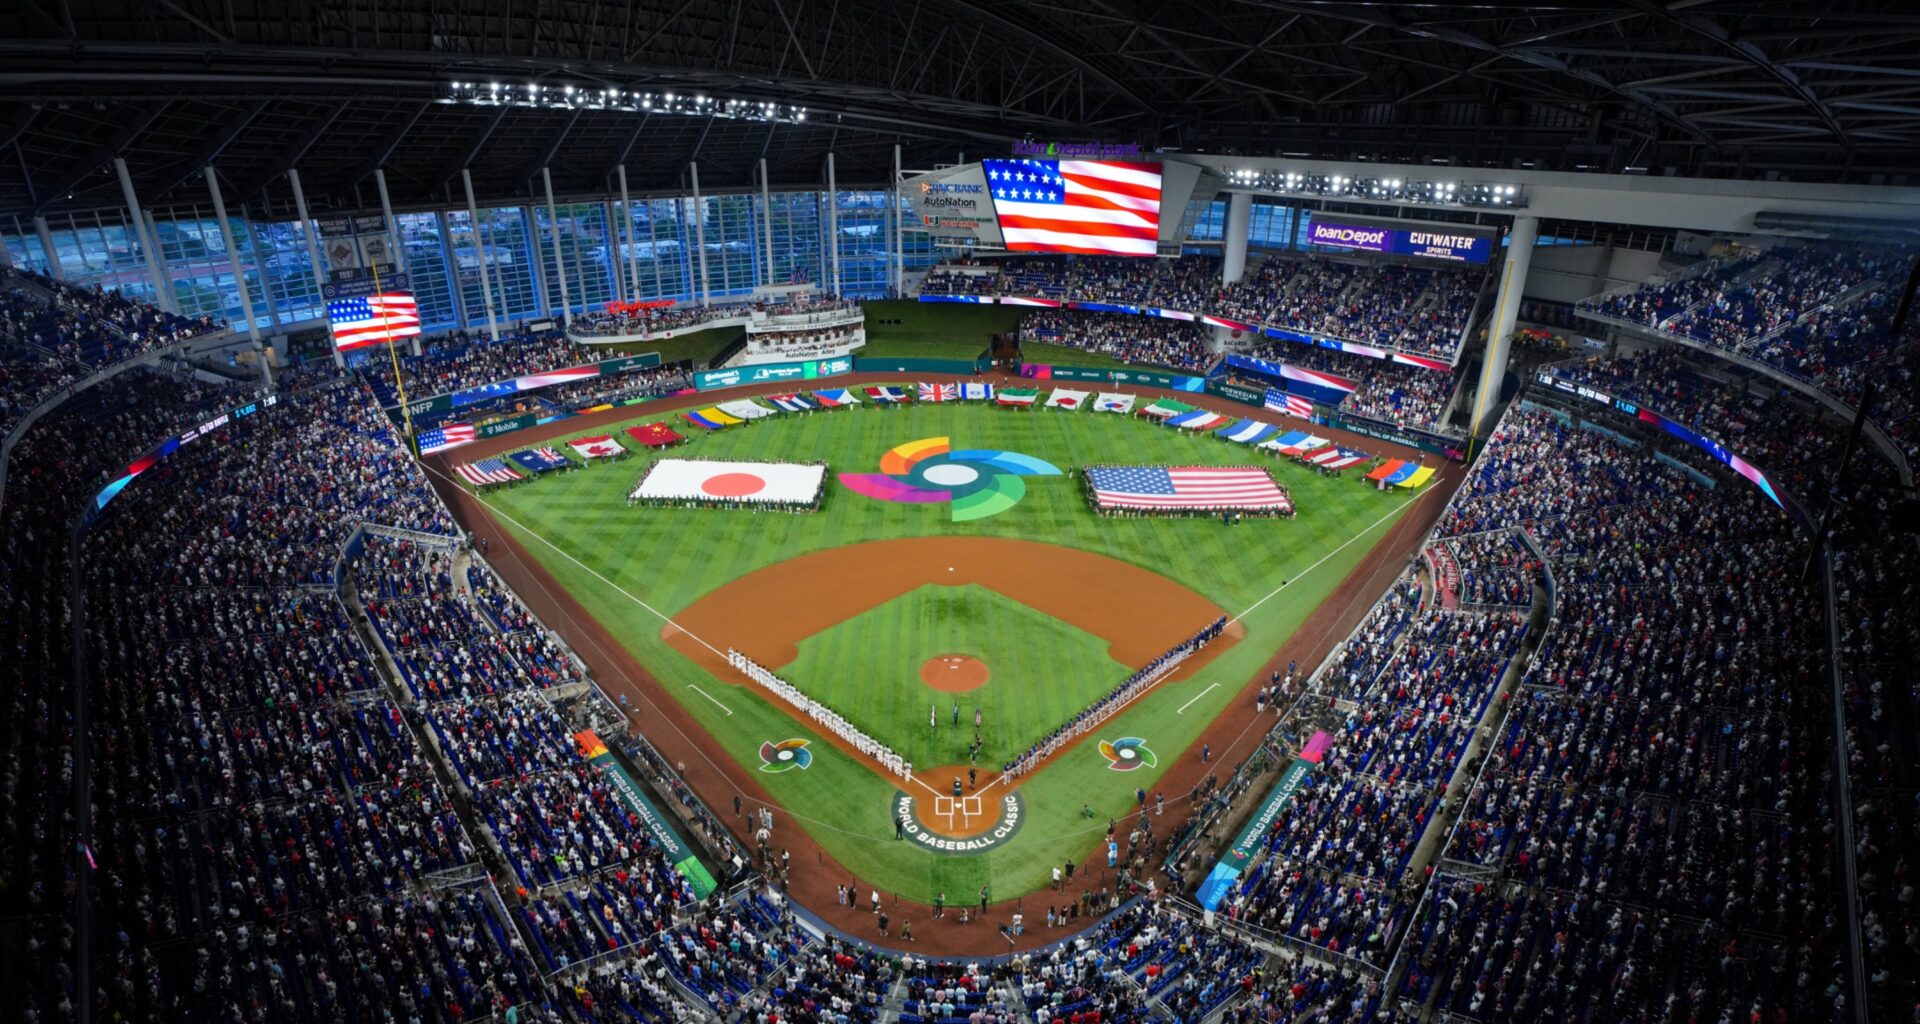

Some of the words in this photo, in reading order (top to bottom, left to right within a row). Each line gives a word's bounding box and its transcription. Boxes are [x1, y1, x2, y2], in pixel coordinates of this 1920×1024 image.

[924, 196, 976, 207] AutoNation
[1314, 224, 1385, 245] loanDepot
[1409, 231, 1474, 250] CUTWATER
[1426, 246, 1452, 256] SPIRITS
[785, 351, 818, 359] AutoNation
[822, 349, 836, 357] Alley
[1220, 386, 1258, 400] NORWEGIAN
[411, 401, 434, 415] NFP
[495, 421, 518, 434] Mobile
[1382, 433, 1391, 441] OF
[1390, 434, 1420, 448] BASEBALL
[608, 769, 632, 792] WORLD
[626, 790, 656, 825] BASEBALL
[651, 822, 680, 855] CLASSIC
[1241, 822, 1266, 849] WORLD
[1261, 791, 1290, 825] BASEBALL
[1283, 765, 1307, 792] CLASSIC
[898, 796, 918, 833] WORLD
[916, 832, 995, 851] BASEBALL
[994, 795, 1019, 838] CLASSIC
